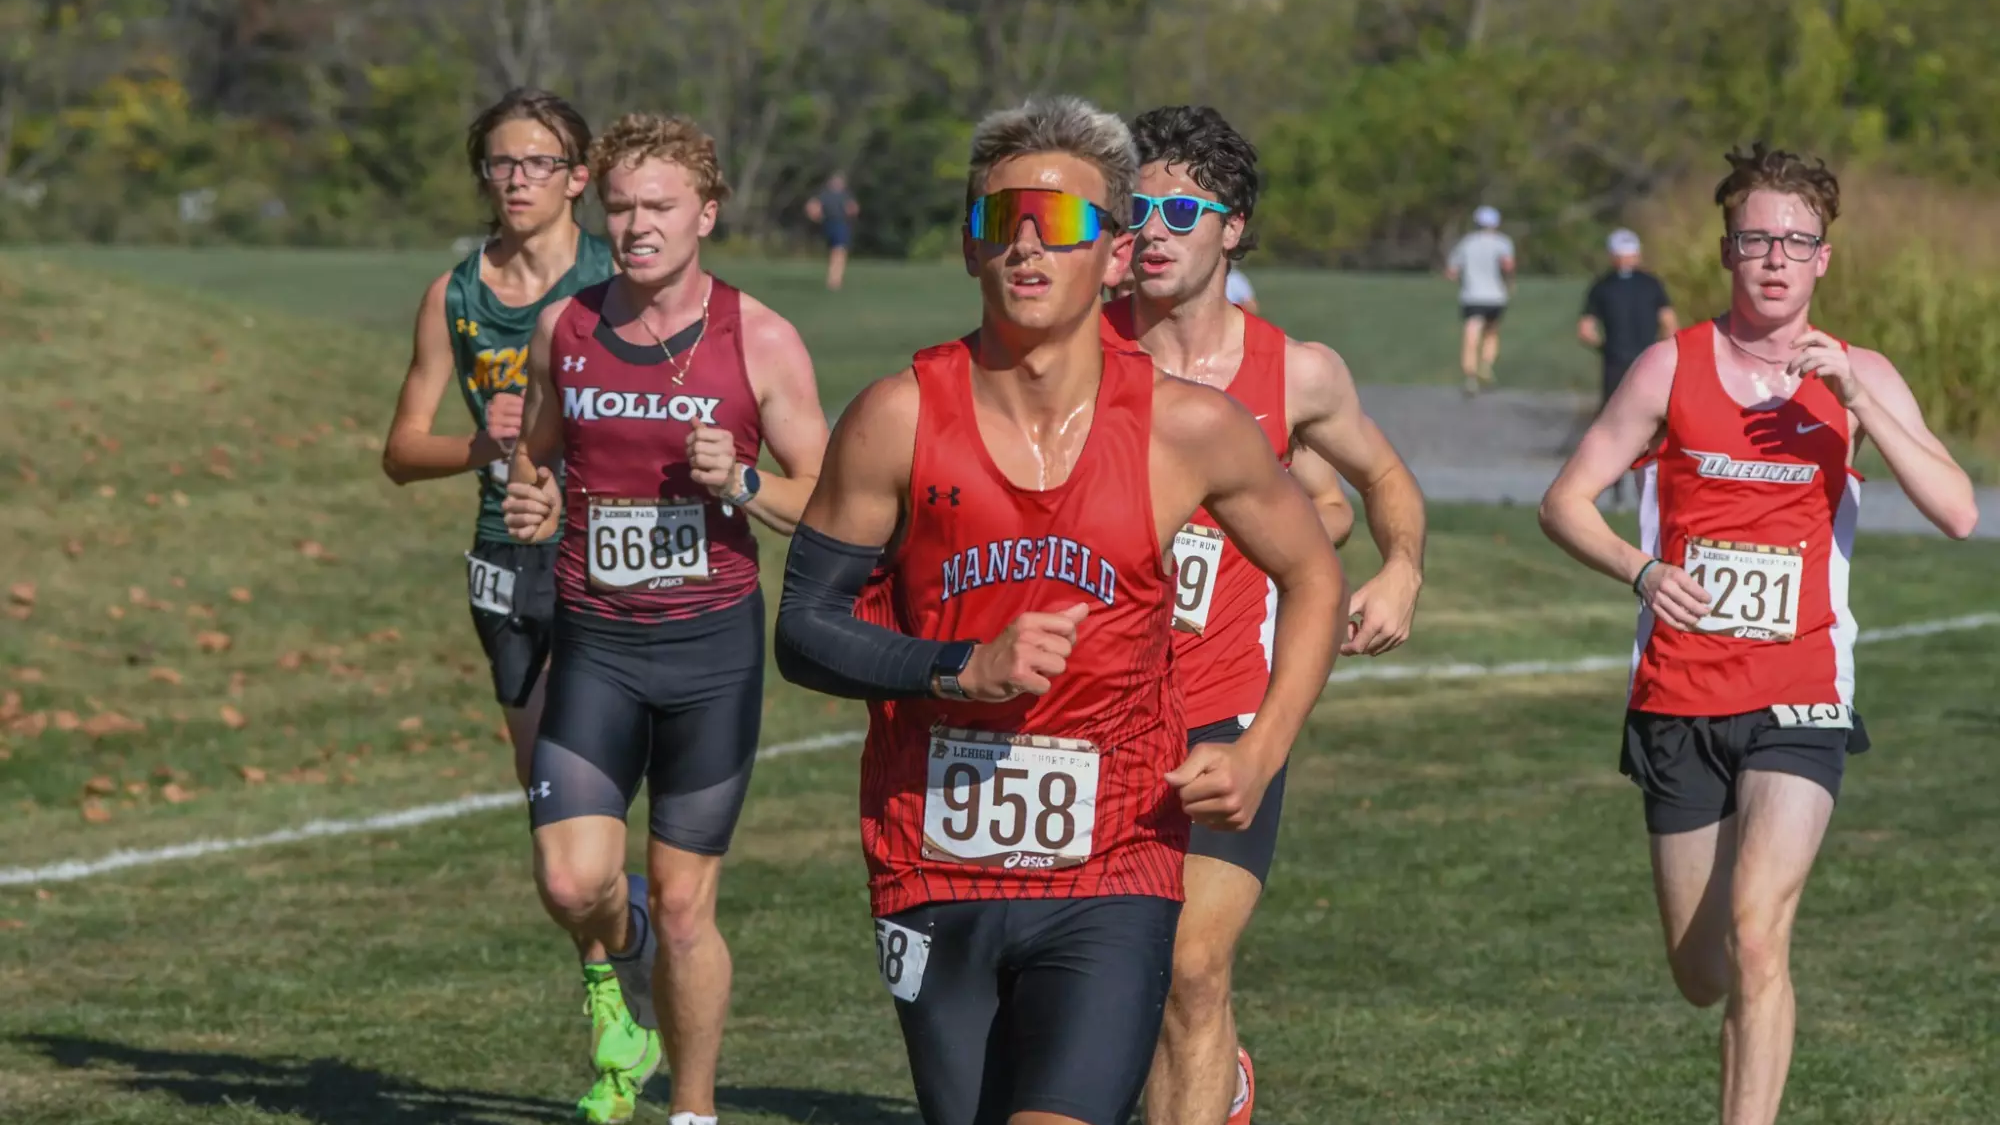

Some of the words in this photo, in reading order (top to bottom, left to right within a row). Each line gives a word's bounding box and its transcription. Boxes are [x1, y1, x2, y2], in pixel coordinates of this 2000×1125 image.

[562, 386, 721, 425] MOLLOY
[1698, 453, 1818, 483] ONEONTA
[595, 525, 700, 571] 6689
[1175, 536, 1197, 548] HORT
[1200, 541, 1217, 552] RUN
[941, 534, 1117, 606] MANSFIELD
[953, 746, 994, 761] LEHIGH
[1032, 754, 1065, 766] HORT
[942, 762, 1077, 850] 958
[1020, 854, 1055, 869] asics
